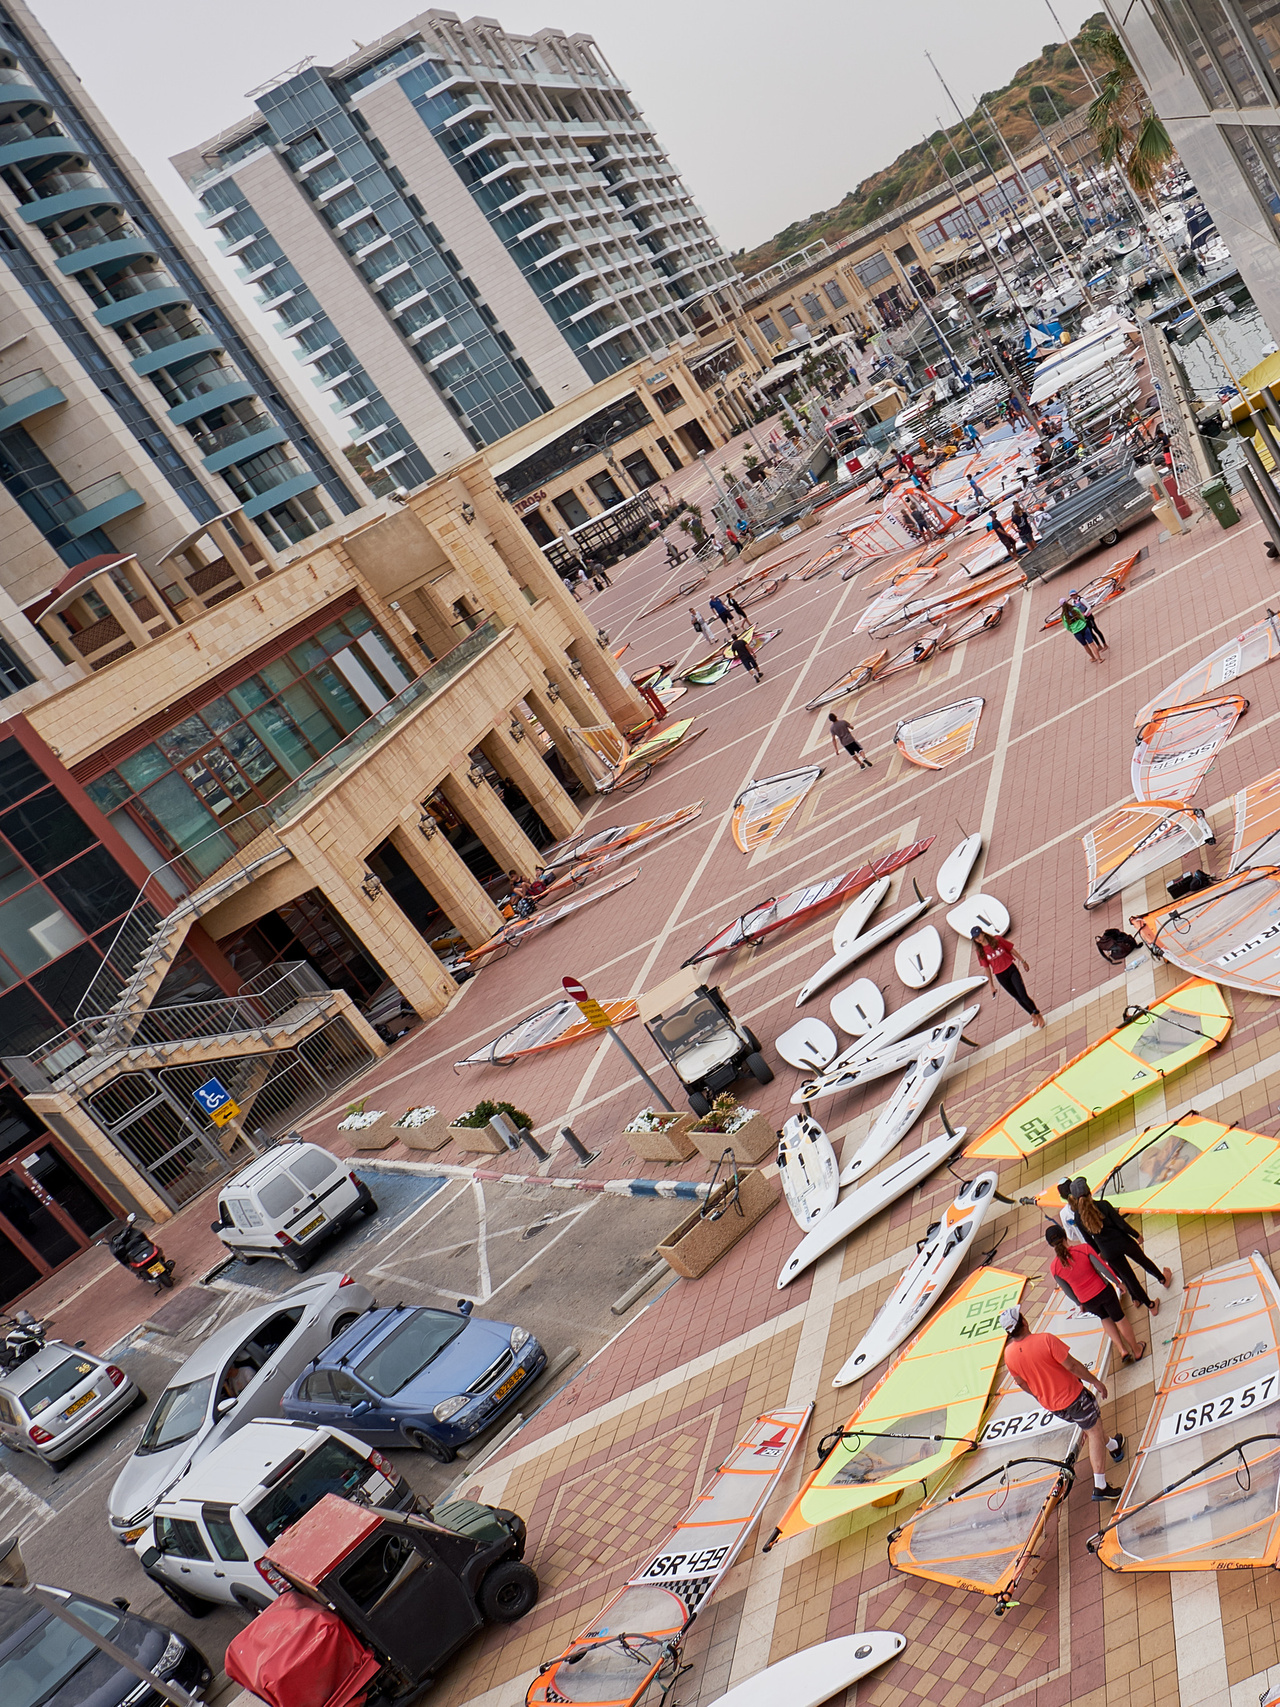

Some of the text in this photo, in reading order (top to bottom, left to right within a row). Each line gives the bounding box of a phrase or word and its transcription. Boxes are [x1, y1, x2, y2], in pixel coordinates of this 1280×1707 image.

[1222, 939, 1261, 962] 441
[1191, 1343, 1268, 1378] caesarstone
[642, 1546, 729, 1578] ISR 439
